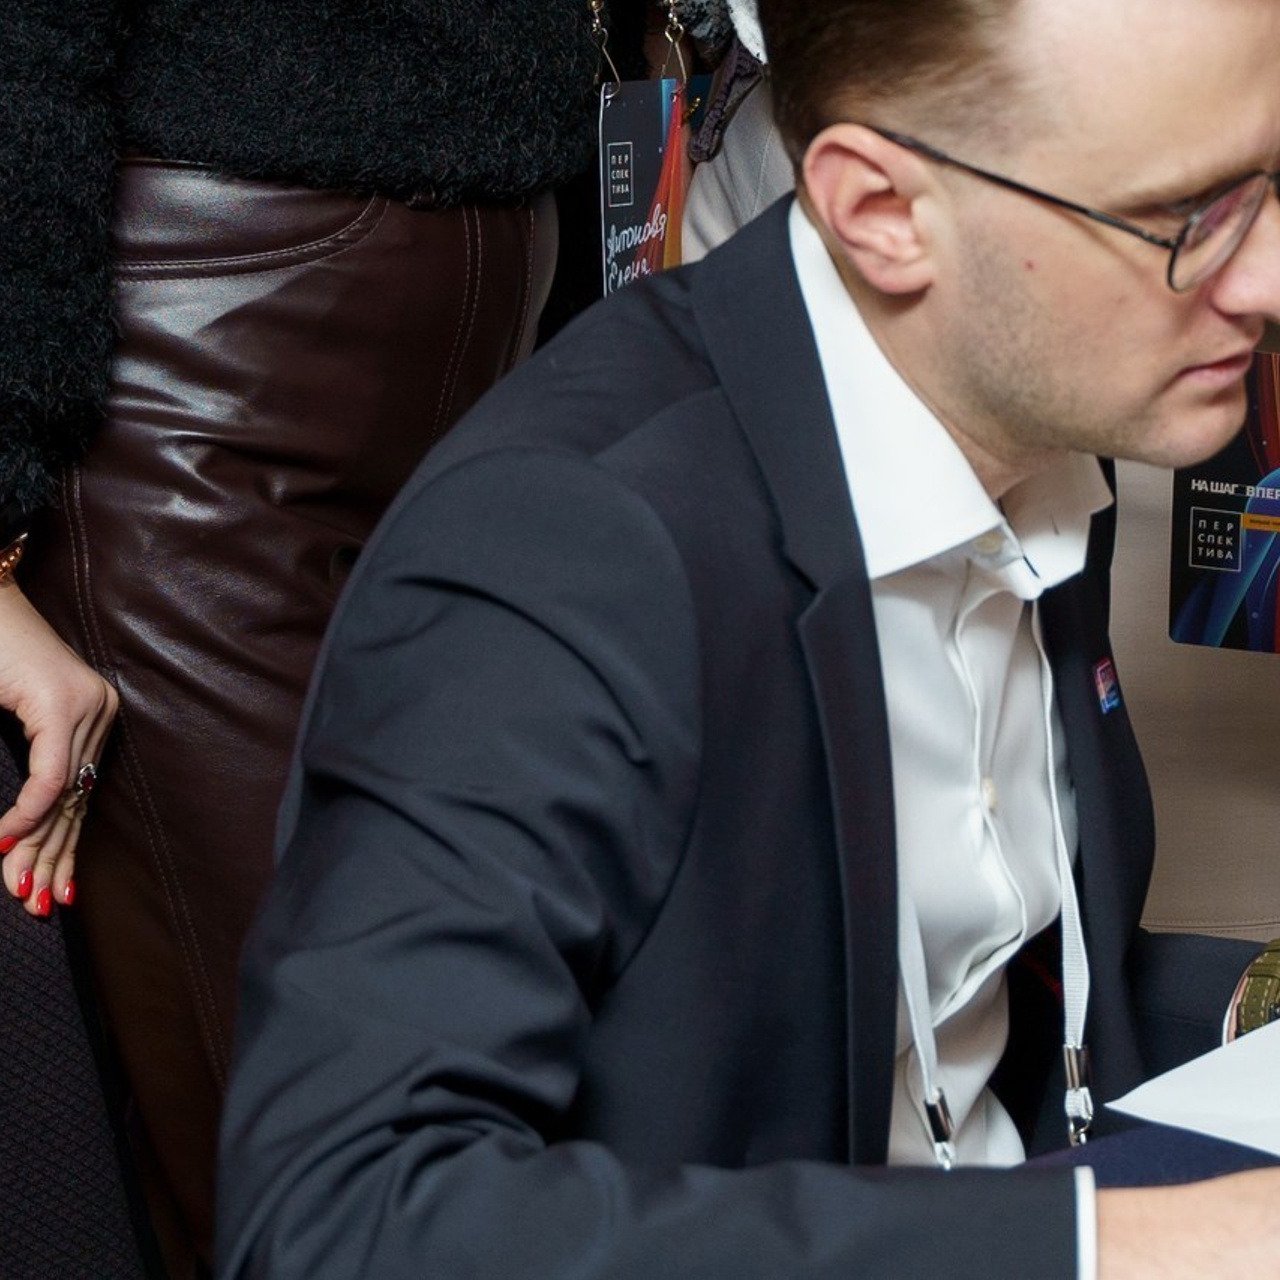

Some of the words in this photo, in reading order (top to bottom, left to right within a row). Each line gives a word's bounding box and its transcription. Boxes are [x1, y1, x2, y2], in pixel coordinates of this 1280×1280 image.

[1191, 479, 1208, 492] НА
[1210, 482, 1239, 495] ШАГ
[1198, 519, 1234, 531] ПЕР
[1197, 533, 1233, 546] СПЕК
[1197, 547, 1233, 560] ТИВА
